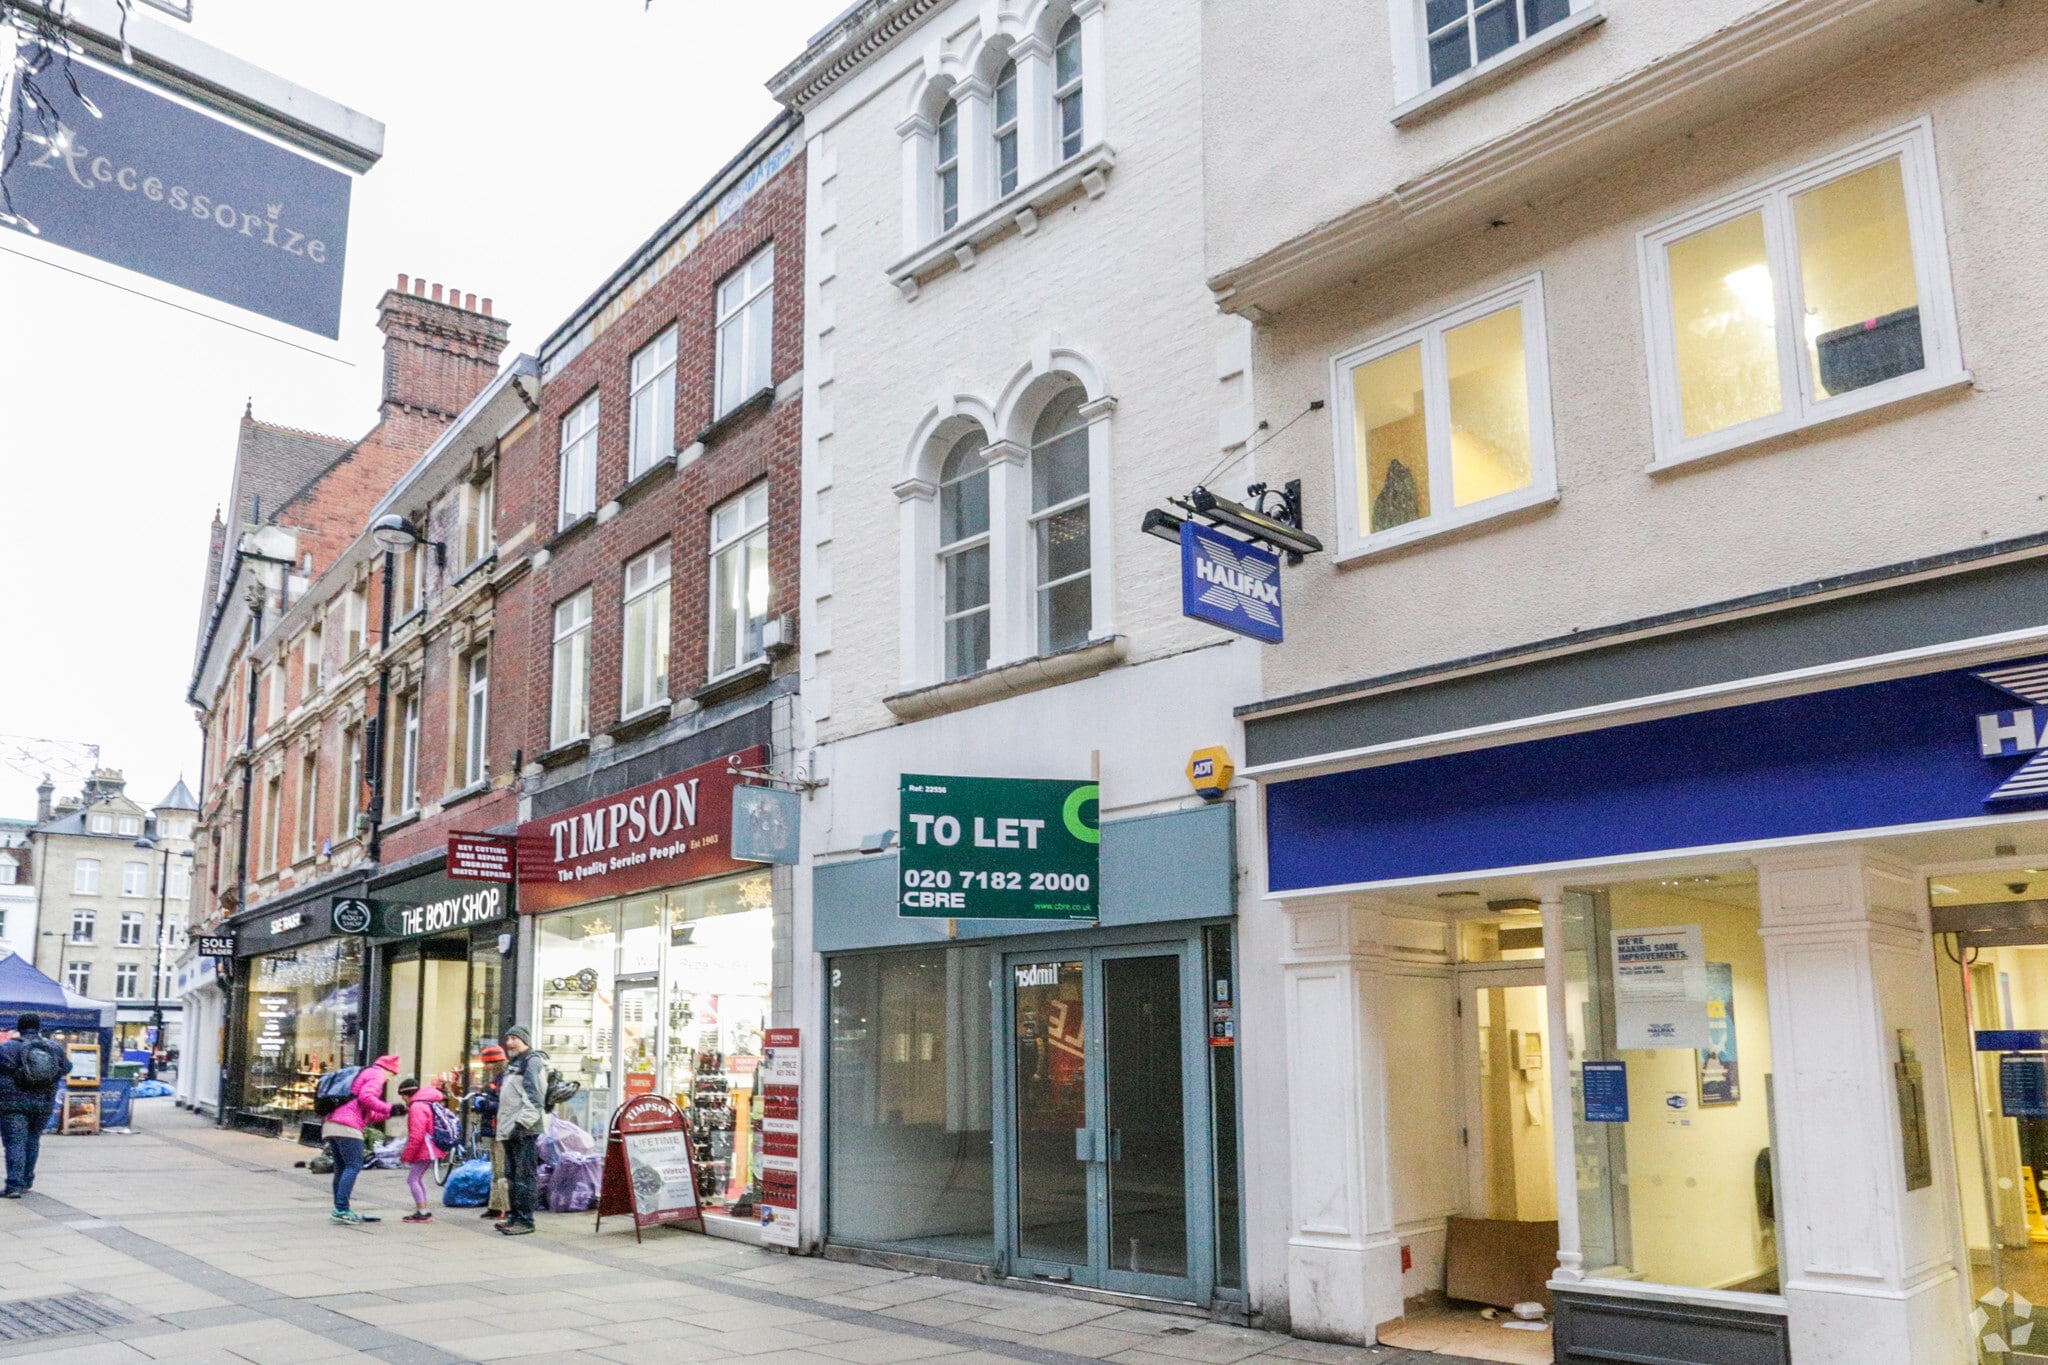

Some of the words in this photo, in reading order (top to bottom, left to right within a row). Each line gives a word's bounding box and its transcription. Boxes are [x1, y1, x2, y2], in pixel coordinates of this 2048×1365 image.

[28, 121, 326, 264] Accessorize
[1196, 557, 1280, 607] HALIFAX
[1193, 760, 1213, 776] ADT
[549, 778, 699, 863] TIMPSON
[909, 813, 961, 846] TO
[974, 817, 1045, 849] LET
[475, 846, 507, 854] CUTTING
[456, 852, 475, 860] SHOE
[477, 853, 509, 862] REPAIRS
[557, 869, 574, 882] The
[575, 861, 608, 881] Quality
[609, 852, 647, 870] Service
[649, 840, 686, 860] People
[702, 834, 718, 847] 1903
[461, 860, 503, 870] ENGRAVING
[452, 867, 478, 876] WATCH
[480, 870, 512, 879] REPAIRS
[904, 869, 952, 889] 020
[959, 871, 1022, 890] 7182
[1029, 872, 1090, 891] 2000
[903, 891, 966, 908] CBRE
[401, 907, 424, 936] THE
[426, 897, 461, 931] BODY
[461, 888, 499, 923] SHOP
[1033, 902, 1092, 911] www.cbre.co.uk
[341, 914, 364, 922] BODY
[201, 938, 233, 948] SOLE
[1617, 937, 1644, 946] WE'RE
[1618, 944, 1652, 954] MAKING
[1654, 943, 1678, 952] SOME
[1618, 951, 1688, 961] IMPROVEMENTS.
[625, 1102, 674, 1121] TIMPSON
[632, 1135, 679, 1147] LIFETIME
